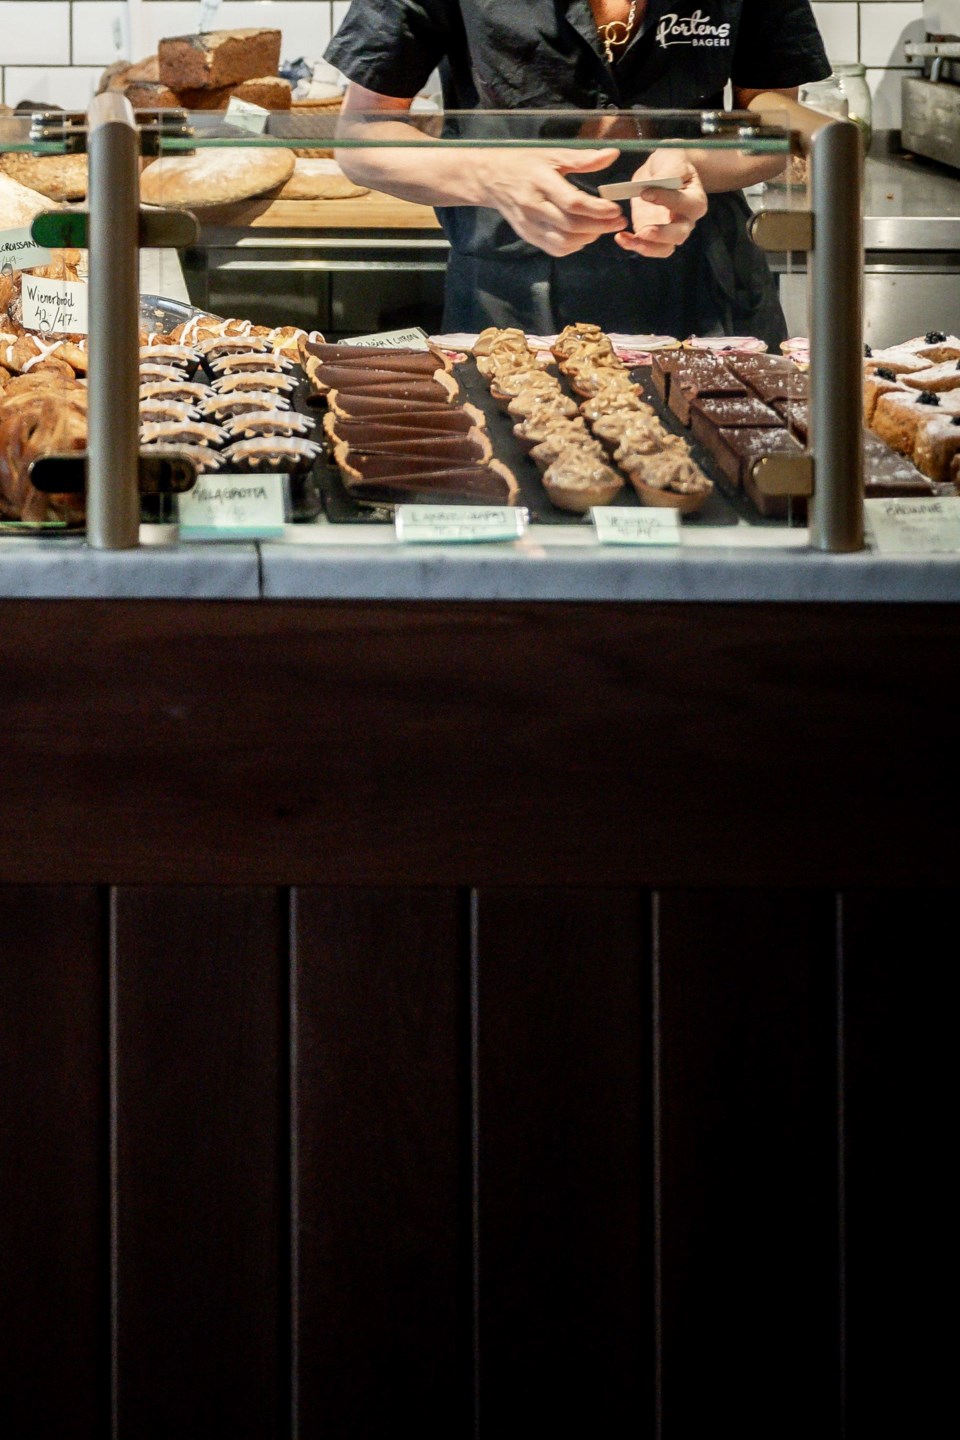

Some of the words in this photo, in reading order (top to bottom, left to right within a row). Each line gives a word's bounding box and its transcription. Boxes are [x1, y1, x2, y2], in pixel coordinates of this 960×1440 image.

[655, 9, 731, 49] Portens
[692, 38, 730, 47] BAGERI
[26, 285, 75, 308] Wienerbröd
